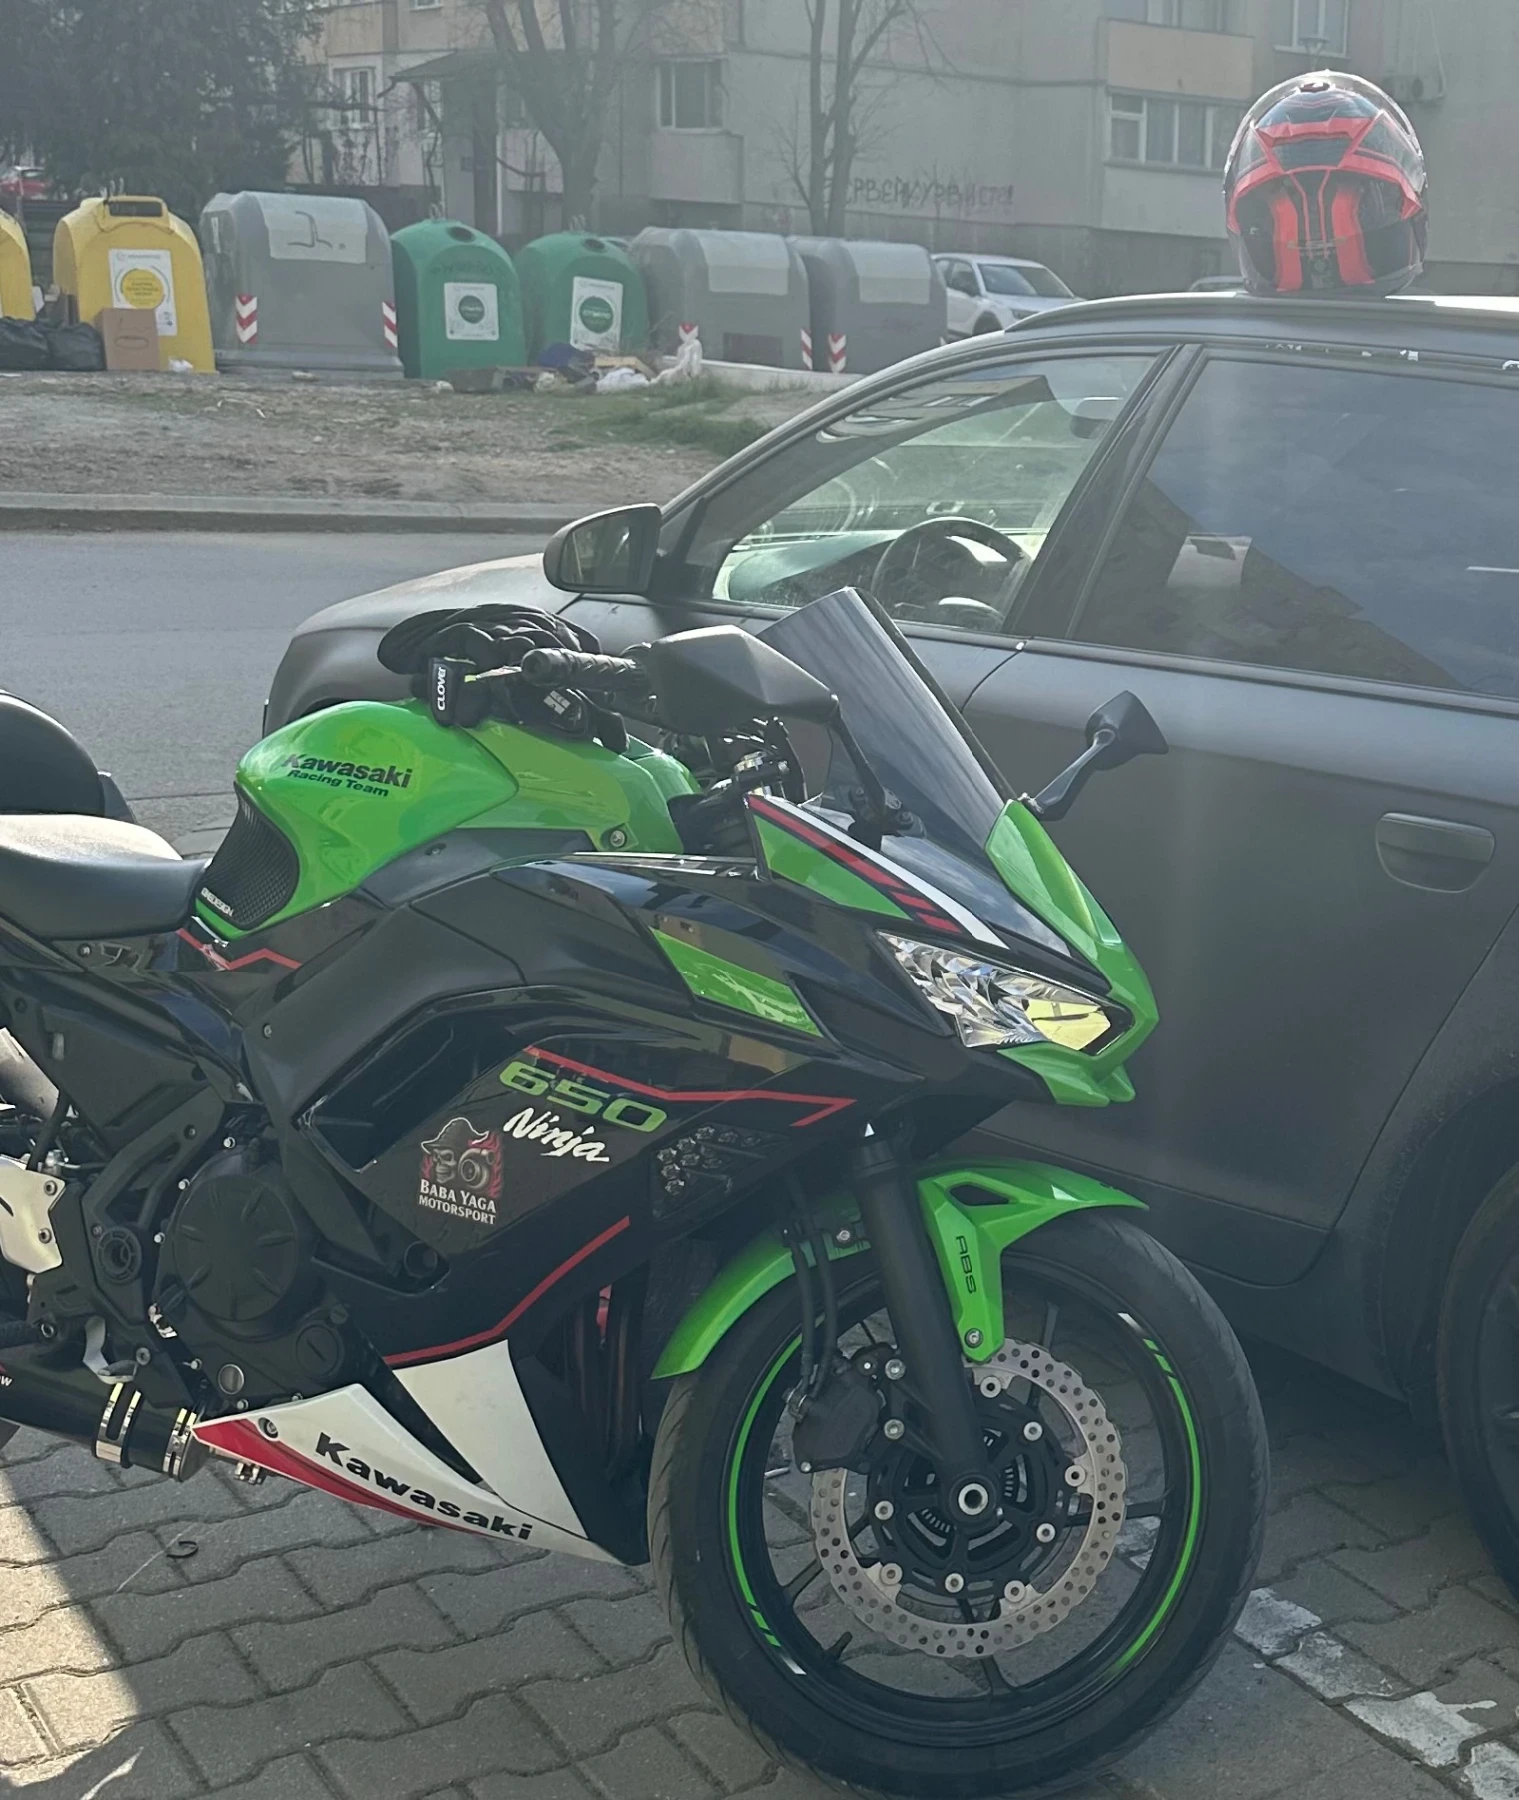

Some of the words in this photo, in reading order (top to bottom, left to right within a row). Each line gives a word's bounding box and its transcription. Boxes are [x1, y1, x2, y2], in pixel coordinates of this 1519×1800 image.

[281, 753, 413, 788] Kawasaki
[287, 769, 343, 787] Racing
[346, 779, 389, 797] Team
[499, 1061, 668, 1133] 650
[503, 1107, 610, 1163] Ninja
[418, 1194, 497, 1225] MOTORSPORT
[420, 1179, 456, 1202] BABA
[460, 1190, 497, 1214] YAGA
[955, 1235, 977, 1294] ABS
[315, 1431, 534, 1541] Kawasaki
